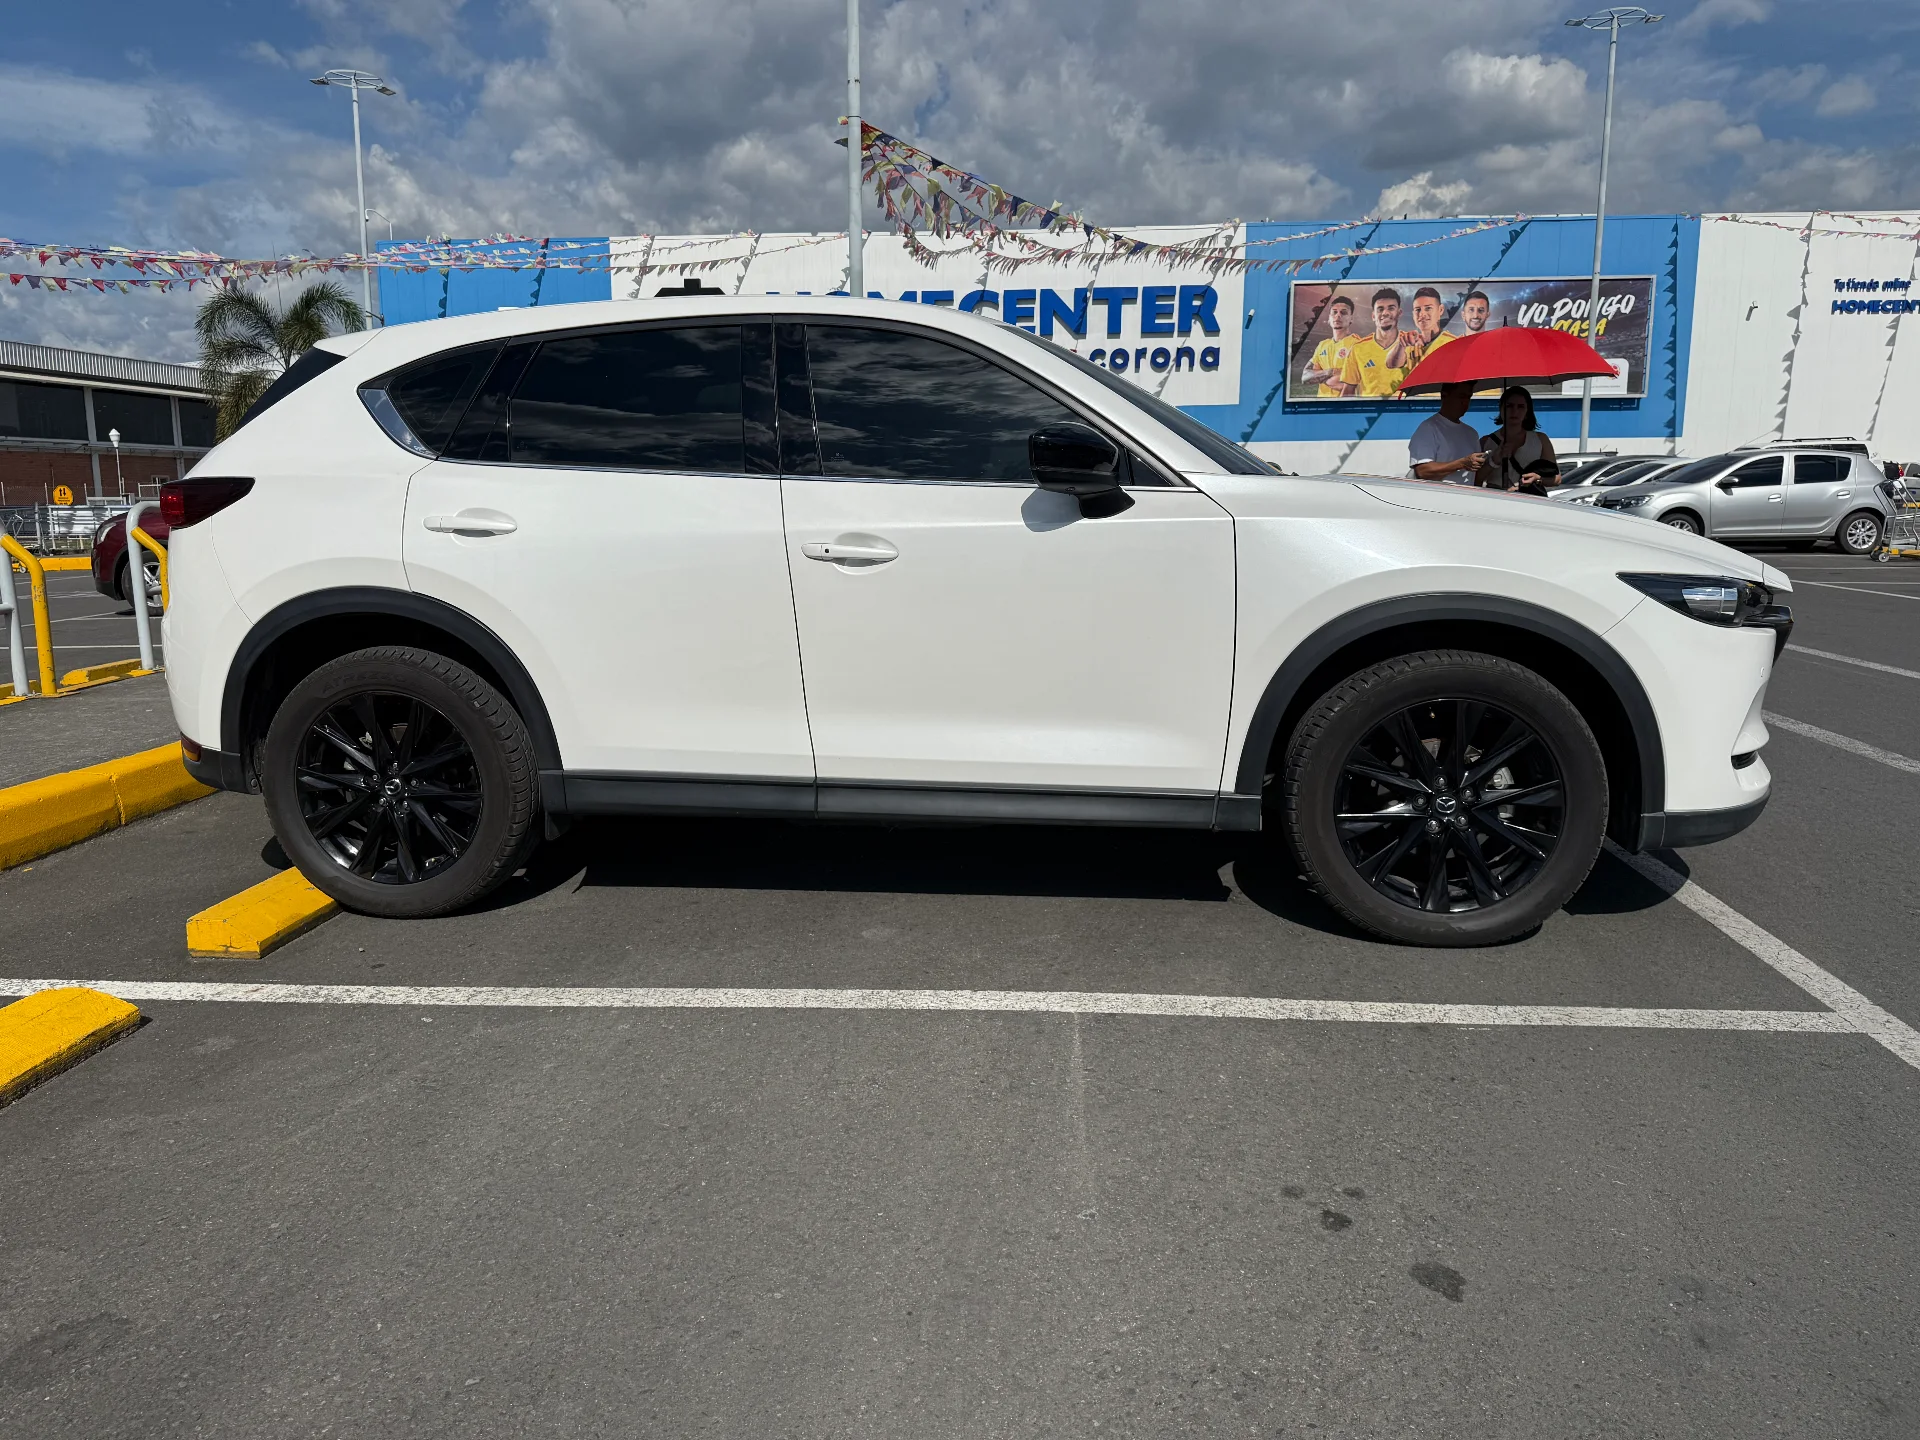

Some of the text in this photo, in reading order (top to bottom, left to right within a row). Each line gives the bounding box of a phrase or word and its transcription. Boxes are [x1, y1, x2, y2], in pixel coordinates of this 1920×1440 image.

[1834, 277, 1911, 292] Tu tienda online
[766, 284, 1221, 338] ENTER
[1517, 302, 1549, 328] YO
[1089, 345, 1221, 372] corona
